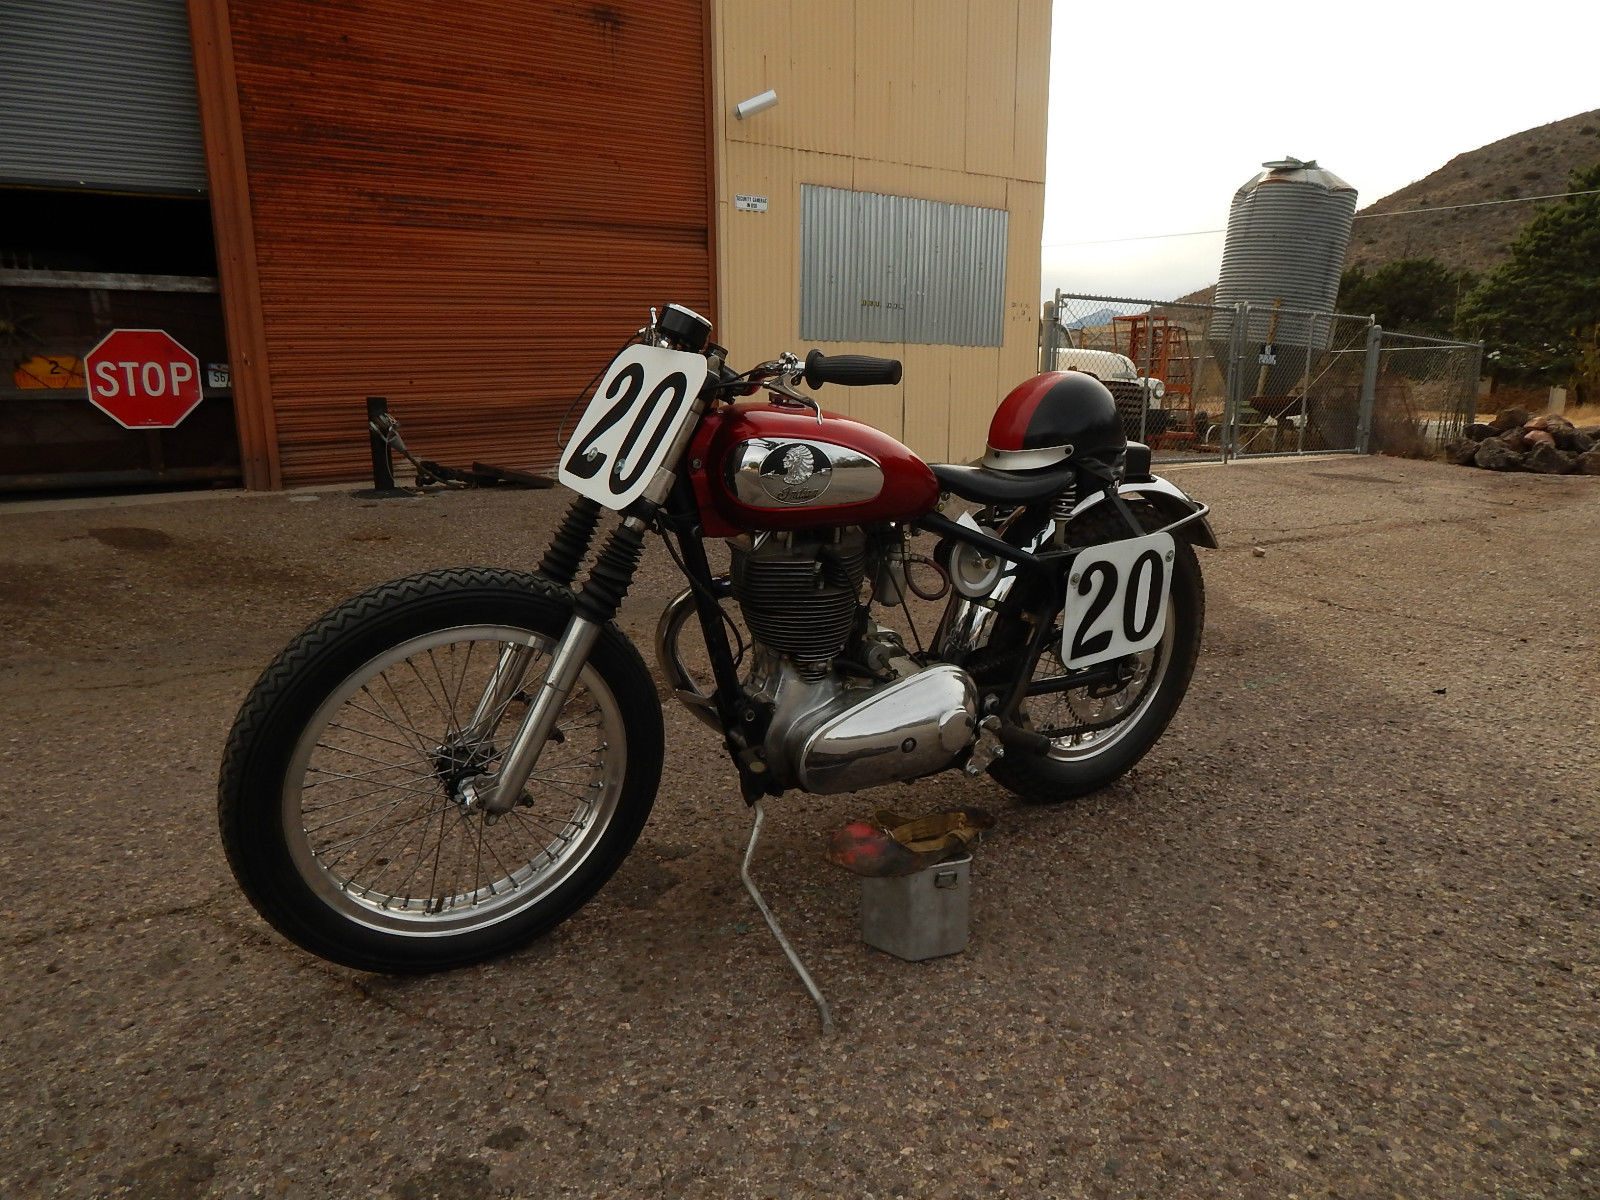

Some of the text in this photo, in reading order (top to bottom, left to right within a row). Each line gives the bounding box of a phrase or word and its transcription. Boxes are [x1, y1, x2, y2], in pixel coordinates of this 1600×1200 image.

[96, 362, 192, 397] STOP
[565, 362, 687, 495] 20
[777, 485, 819, 501] Indian
[1070, 549, 1164, 660] 20
